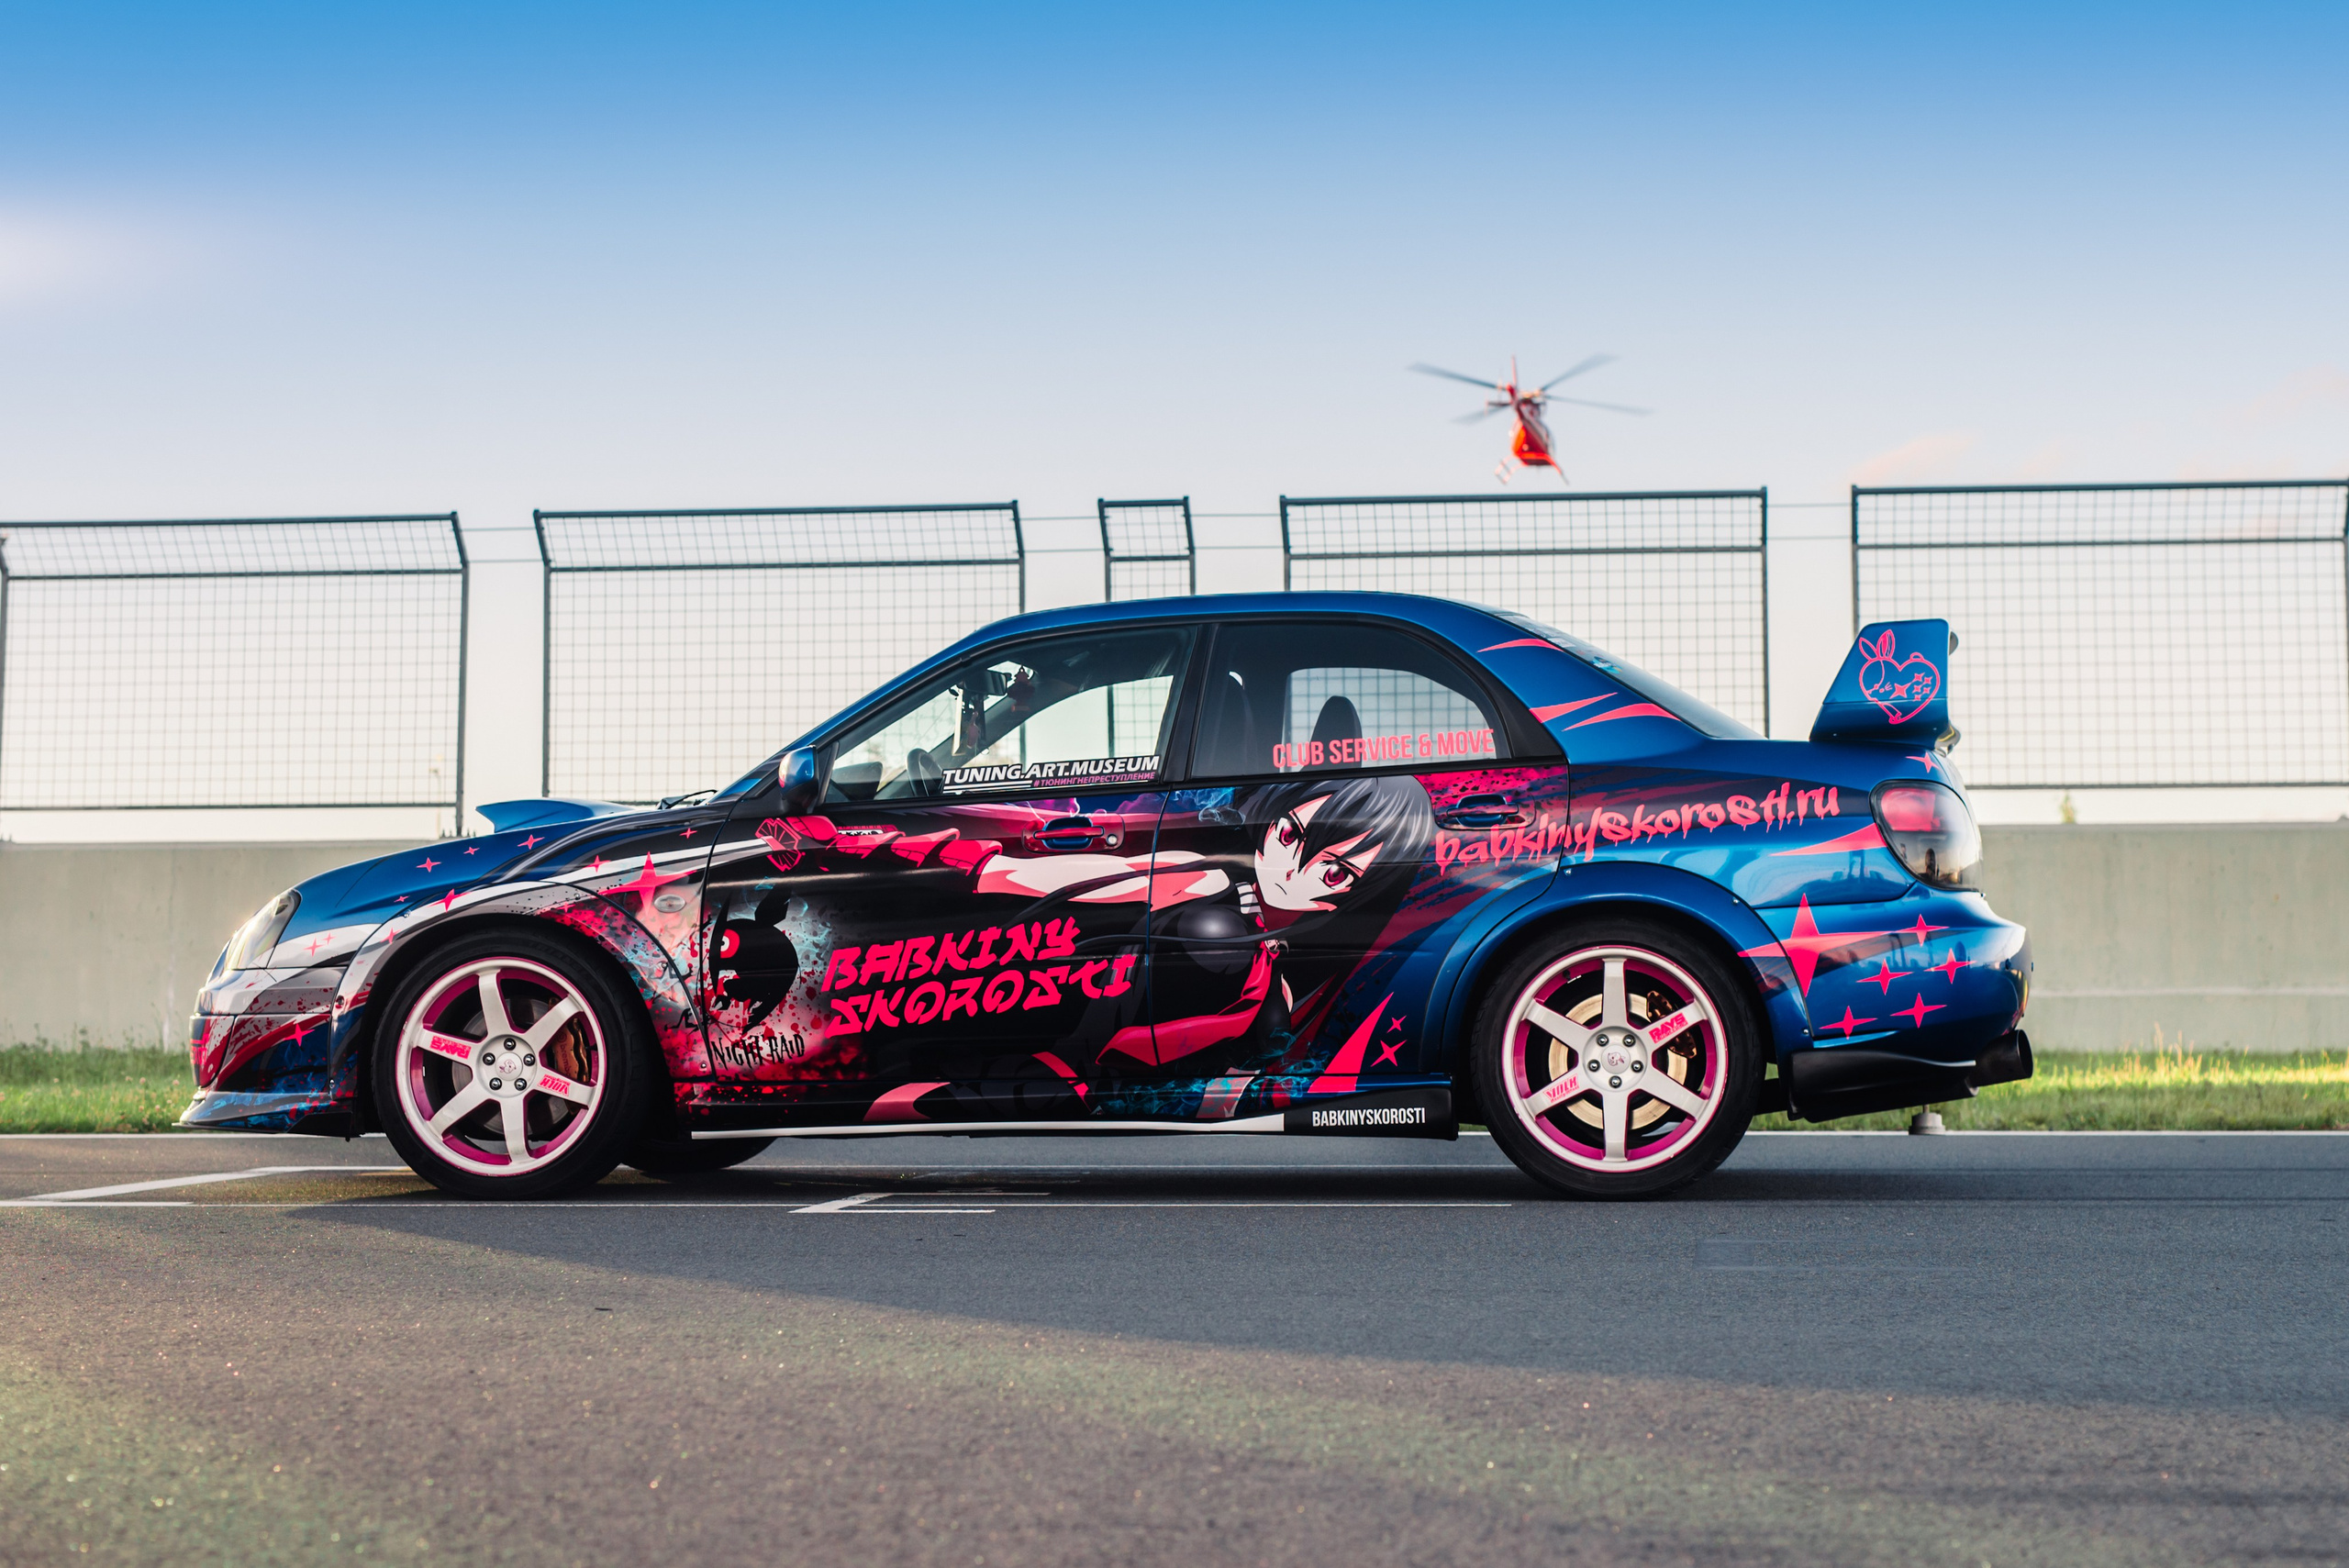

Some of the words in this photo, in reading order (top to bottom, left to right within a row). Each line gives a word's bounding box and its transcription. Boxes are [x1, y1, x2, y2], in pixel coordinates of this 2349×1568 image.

[1273, 741, 1324, 768] CLUB
[1329, 734, 1413, 764] SERVICE
[1419, 733, 1432, 757] &
[1437, 728, 1495, 756] MOVE
[942, 755, 1159, 784] TUNING.ART.MUSEUM
[1435, 782, 1841, 875] babkinyskorosti.ru
[820, 917, 1081, 992] BABKINY
[1312, 1106, 1426, 1128] BABKINYSKOROSTI
